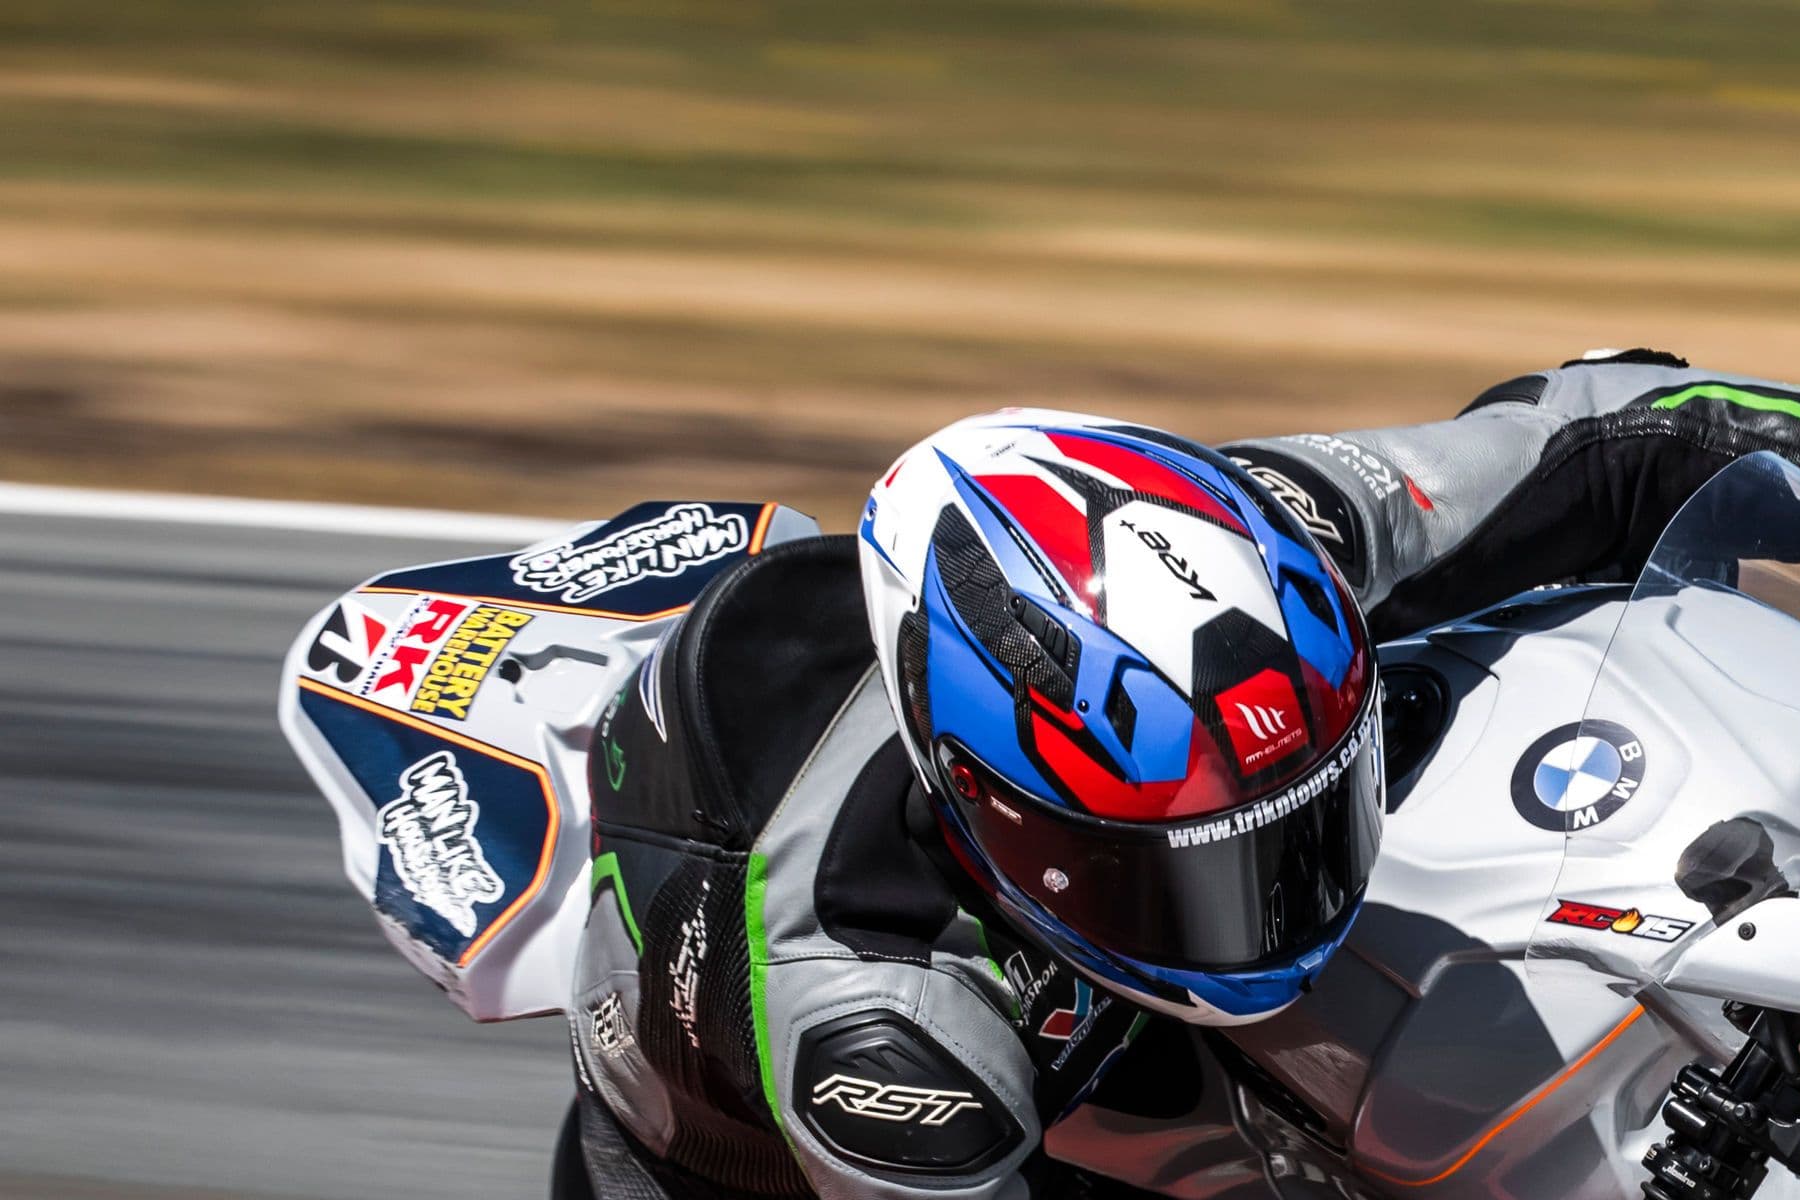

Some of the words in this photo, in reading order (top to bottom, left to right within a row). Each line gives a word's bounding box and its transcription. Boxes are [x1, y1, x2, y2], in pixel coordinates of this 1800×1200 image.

[373, 599, 468, 696] RK
[413, 606, 500, 714] WAREHOUSE
[436, 609, 534, 720] BATTERY
[812, 1073, 983, 1126] RST
